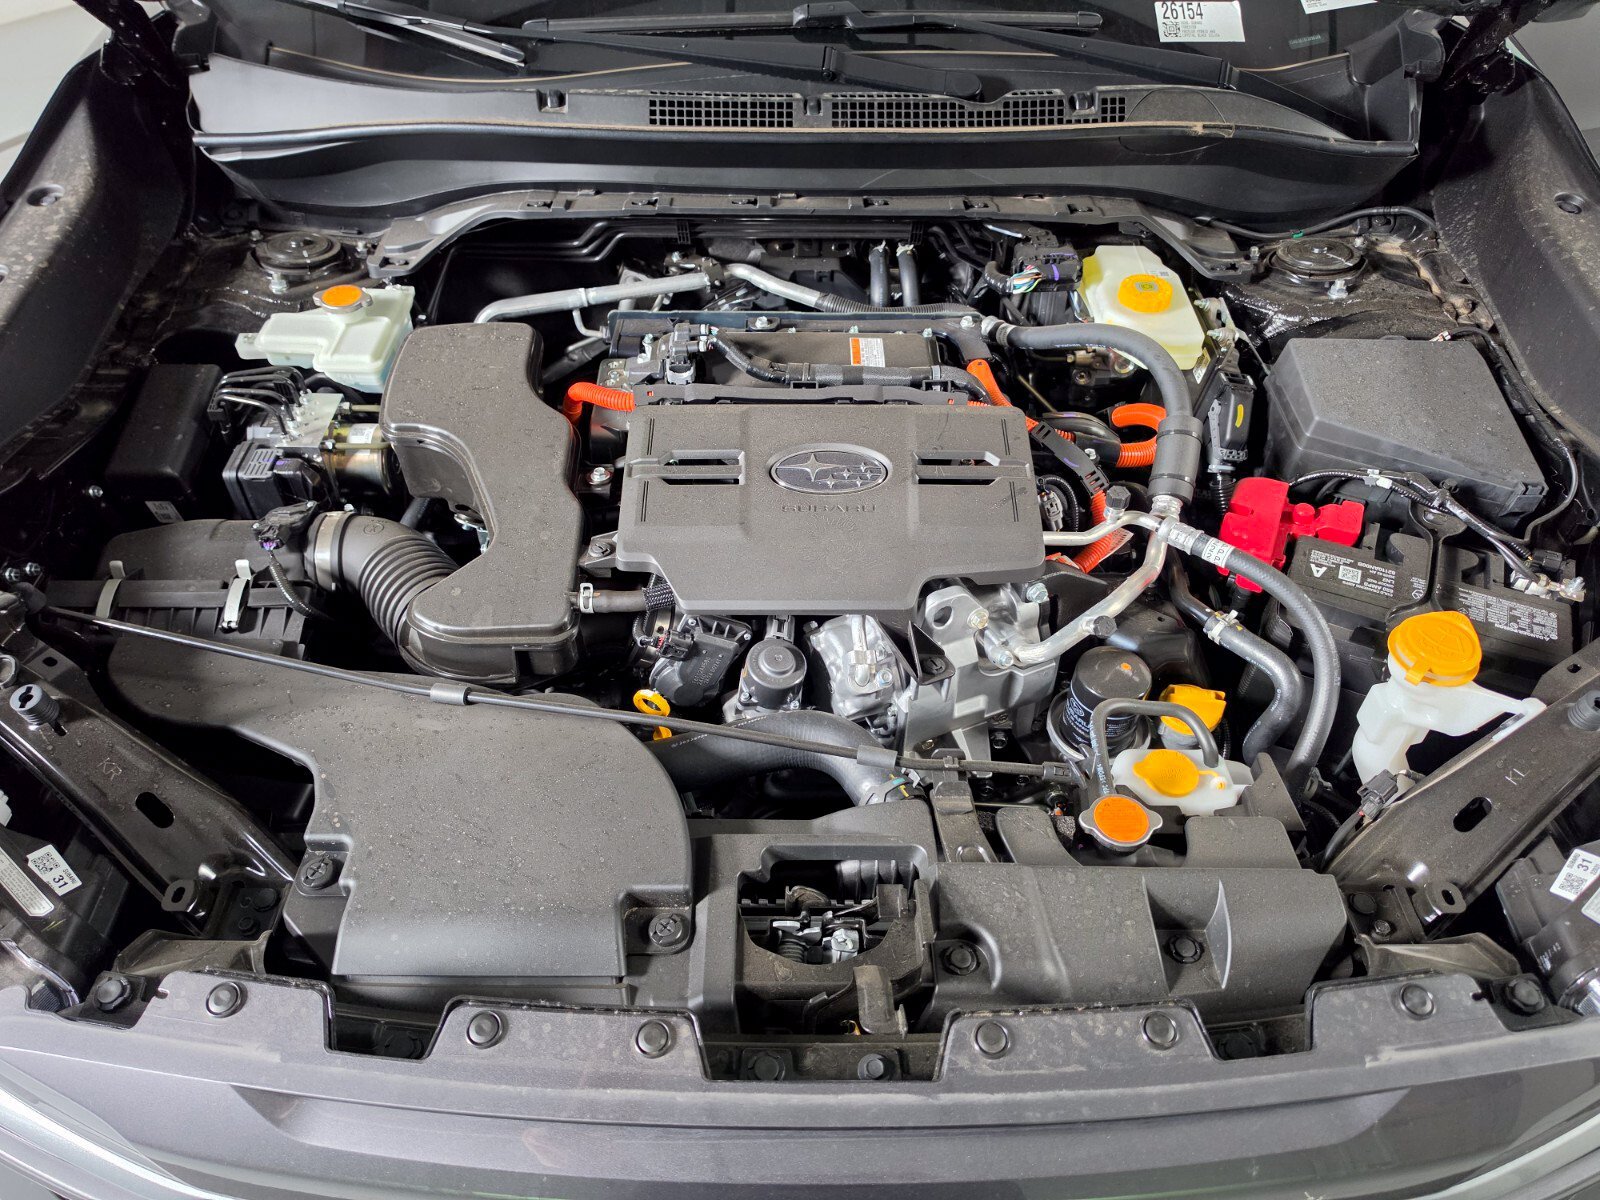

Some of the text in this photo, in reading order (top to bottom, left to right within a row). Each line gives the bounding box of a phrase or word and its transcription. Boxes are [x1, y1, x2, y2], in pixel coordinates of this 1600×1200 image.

[1161, 2, 1203, 19] 26154
[781, 504, 877, 513] SUBARU
[1310, 563, 1327, 577] A
[97, 757, 122, 781] KR
[1504, 768, 1531, 786] KL
[1576, 858, 1593, 872] 31
[53, 875, 68, 888] 31
